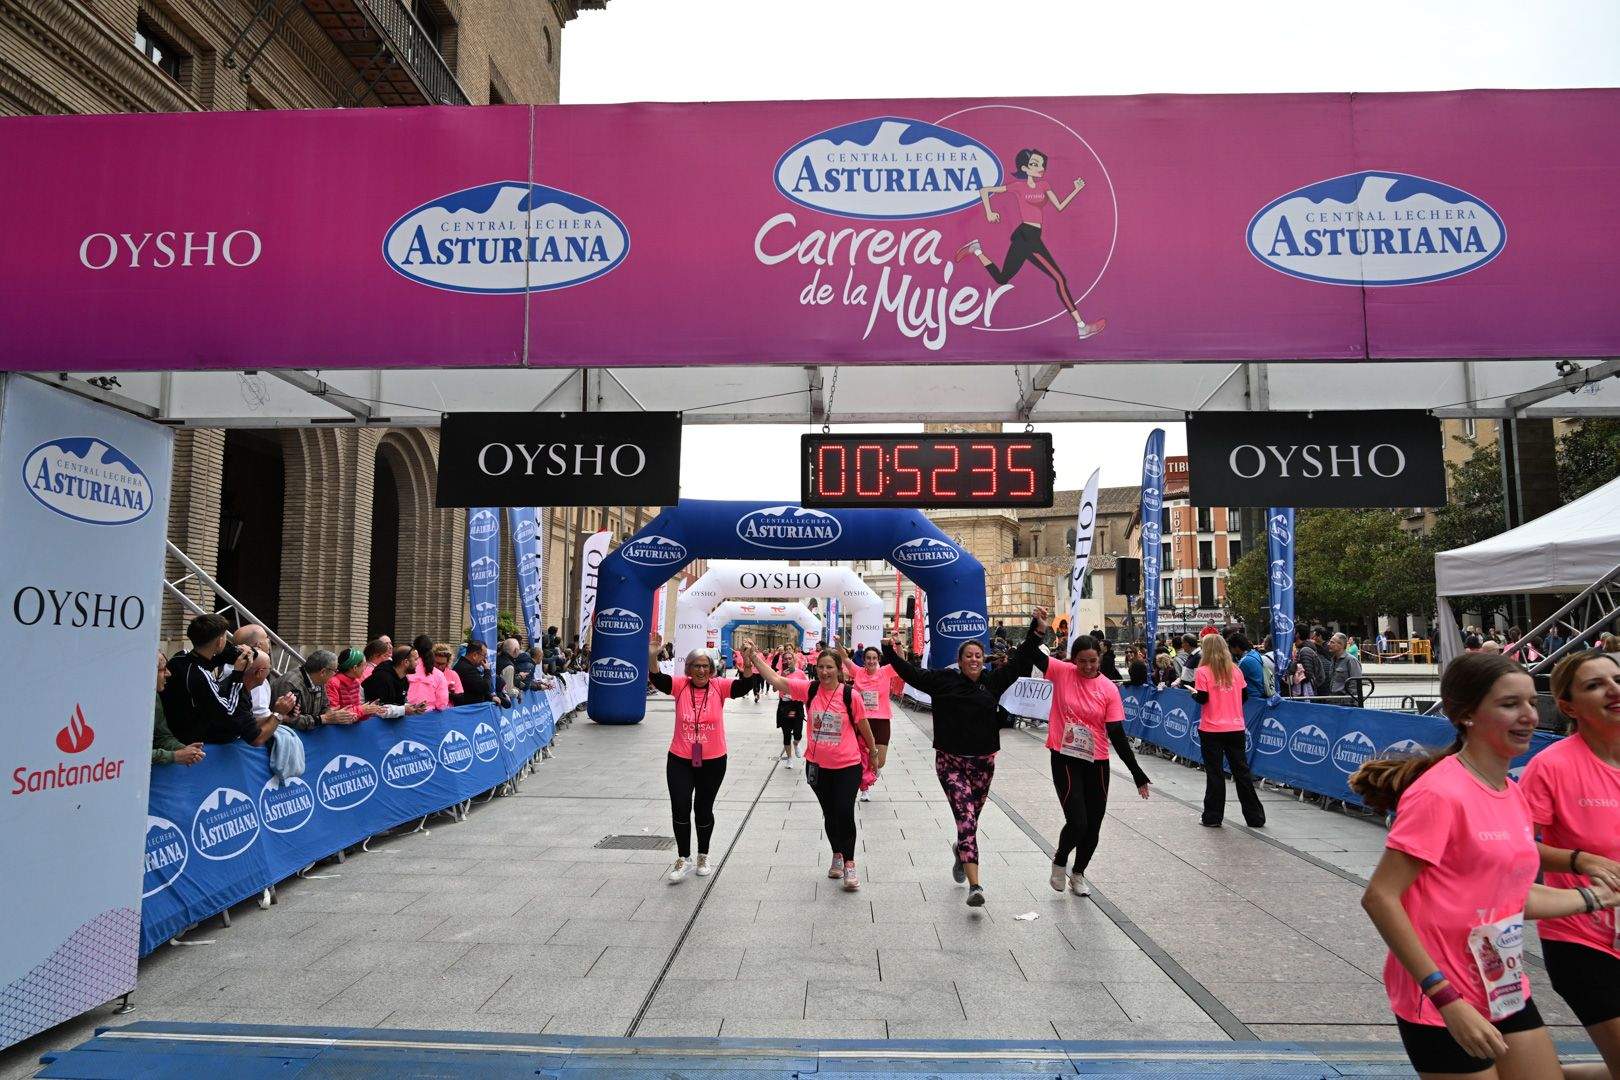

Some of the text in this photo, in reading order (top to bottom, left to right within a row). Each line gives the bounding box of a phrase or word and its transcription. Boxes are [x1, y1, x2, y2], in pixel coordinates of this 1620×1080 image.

[827, 152, 977, 162] CENTRAL LECHERA
[792, 155, 984, 193] ASTURIANA
[440, 218, 603, 232] CENTRAL LECHERA
[1306, 209, 1477, 222] CENTRAL LECHERA
[79, 229, 263, 270] OYSHO
[401, 224, 611, 265] ASTURIANA
[754, 212, 942, 267] Carrera
[1268, 215, 1488, 257] ASTURIANA
[799, 267, 868, 306] de la
[861, 261, 1015, 352] Mujer
[56, 459, 143, 487] CENTRAL LECHERA
[478, 442, 646, 477] OYSHO
[1168, 462, 1189, 473] TIB
[1229, 443, 1406, 478] OYSHO
[33, 457, 144, 511] ASTURIANA
[744, 518, 834, 538] ASTURIANA
[1174, 511, 1182, 552] HOTEL
[625, 546, 682, 559] ASTURIANA
[898, 549, 955, 561] ASTURIANA
[740, 572, 821, 590] OYSHO
[13, 586, 145, 631] OYSHO
[596, 616, 640, 629] ASTURIANA
[591, 665, 635, 680] ASTURIANA
[1015, 681, 1053, 700] OYSHO
[1260, 734, 1284, 748] TURIANA
[1291, 736, 1326, 757] ASTURIANA
[387, 757, 434, 781] ASTURIANA
[443, 747, 472, 766] ASTURIANA
[11, 758, 125, 796] Santander
[322, 773, 375, 803] ASTURIANA
[264, 794, 312, 823] ASTURIANA
[199, 812, 258, 851] ASTURIANA
